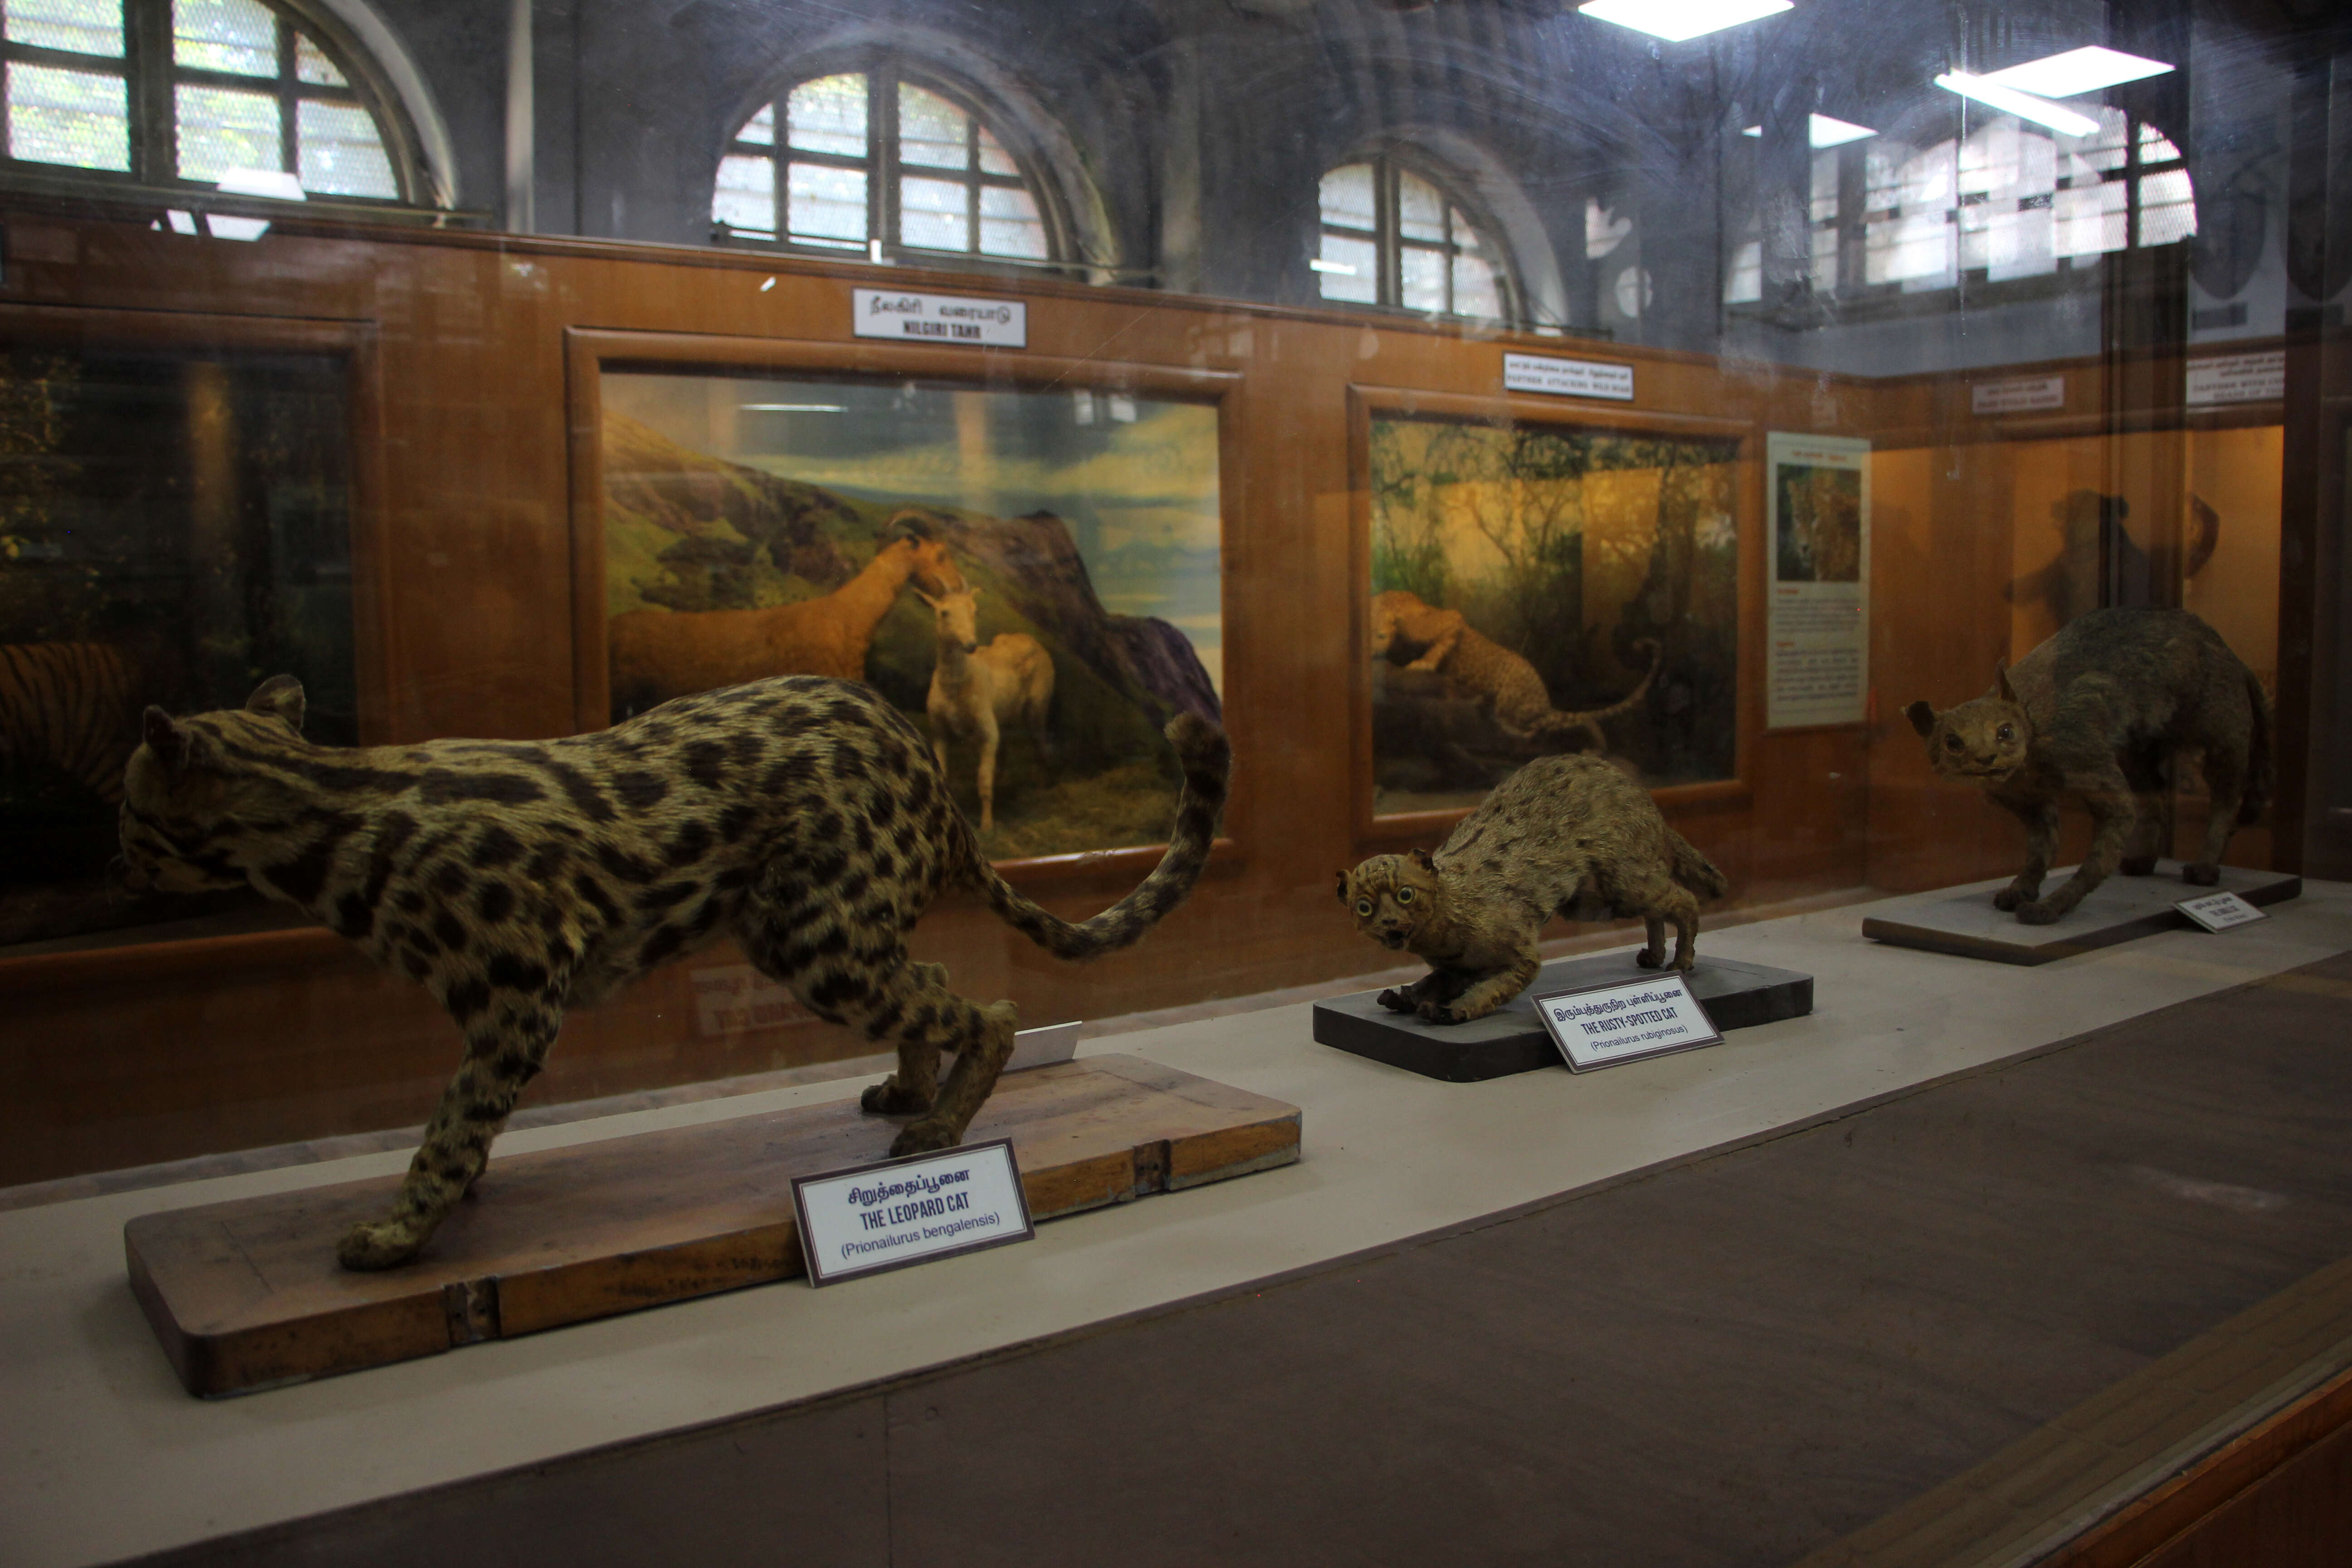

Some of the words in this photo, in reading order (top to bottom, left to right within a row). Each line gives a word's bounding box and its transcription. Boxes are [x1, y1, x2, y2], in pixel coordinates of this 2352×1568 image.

[903, 319, 947, 337] NILGIRI
[951, 323, 981, 339] TAHR
[1581, 1022, 1600, 1035] THE
[1601, 1010, 1662, 1030] RUSTY-SPOTTED
[1663, 1007, 1678, 1019] CAT
[1590, 1035, 1640, 1051] (Prionailurus
[1641, 1024, 1688, 1039] rubiginosus)
[848, 1169, 970, 1206] சிறுத்தைப்பூனை
[860, 1210, 883, 1230] THE
[888, 1199, 944, 1224] LEOPARD
[947, 1191, 970, 1212] CAT
[841, 1230, 920, 1259] (Prionailurus
[923, 1211, 1000, 1239] bengalensis)
